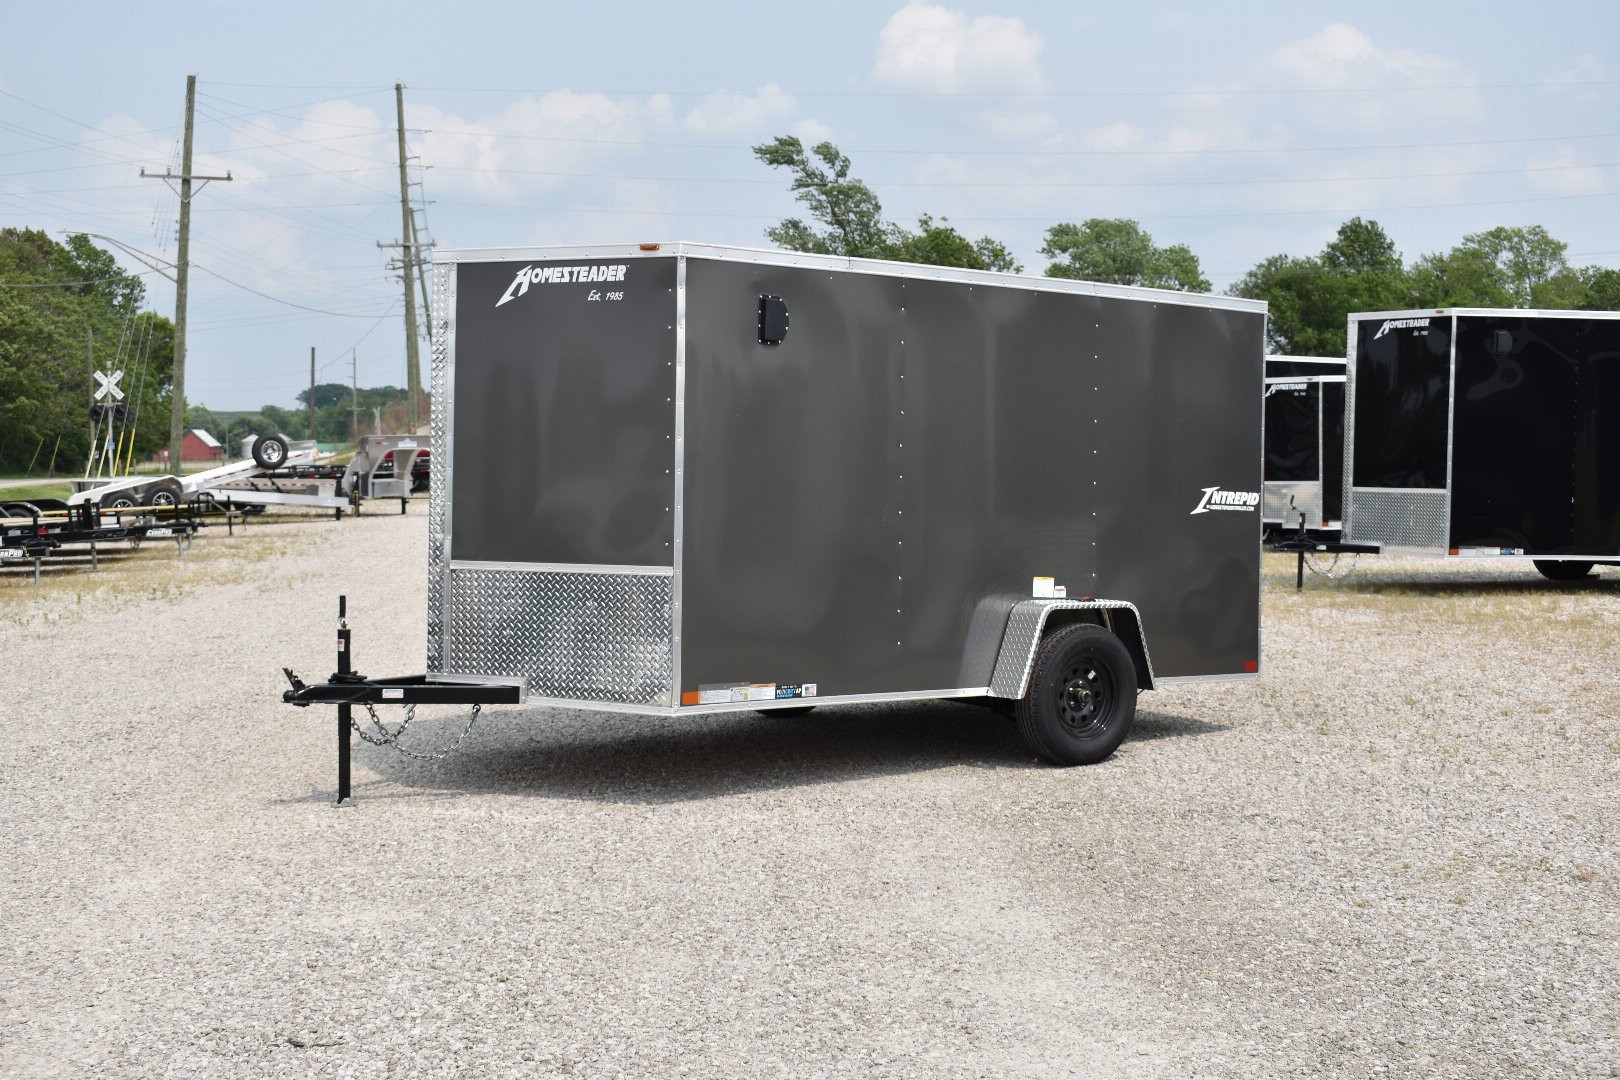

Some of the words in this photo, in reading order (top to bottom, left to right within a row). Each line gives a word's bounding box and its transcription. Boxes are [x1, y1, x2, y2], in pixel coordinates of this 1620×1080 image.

[495, 264, 627, 307] HOMESTEADER
[605, 291, 624, 301] 1985
[1373, 318, 1430, 340] HOMESTEADER
[1189, 486, 1260, 515] INTREPID
